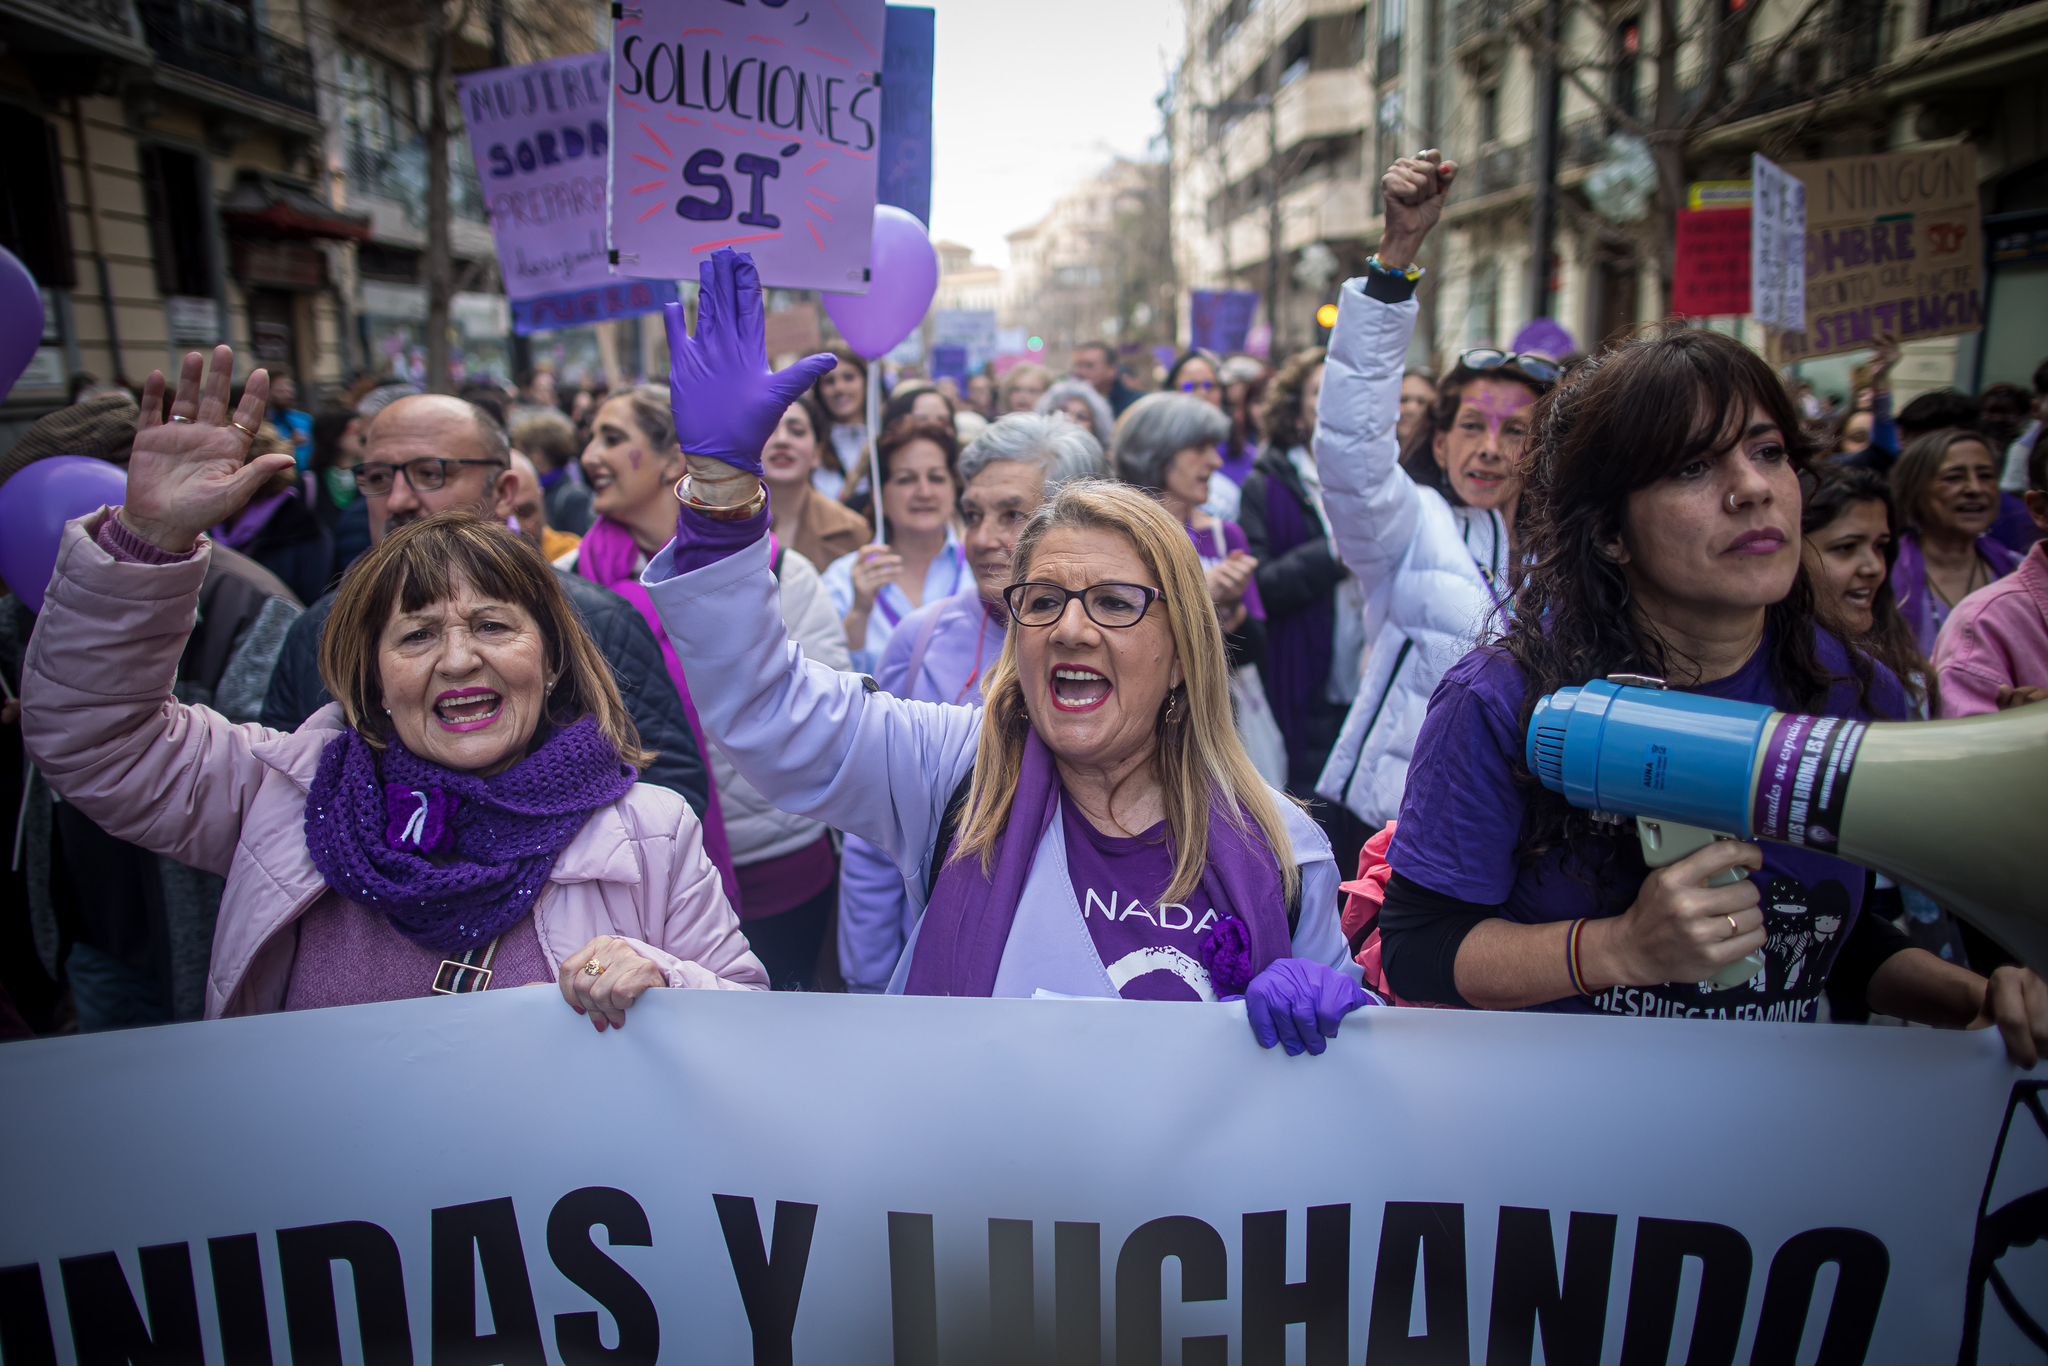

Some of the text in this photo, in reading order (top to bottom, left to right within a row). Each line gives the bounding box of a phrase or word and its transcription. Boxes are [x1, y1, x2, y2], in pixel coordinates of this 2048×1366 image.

[620, 36, 875, 150] SOLUCIONES
[676, 143, 802, 230] SÍ
[1826, 151, 1966, 212] NINGÚN
[1774, 763, 1788, 780] su
[1790, 800, 1809, 823] UNA
[1805, 739, 1825, 753] ES
[711, 1193, 819, 1366] Y
[887, 1201, 1891, 1366] LUCHANDO
